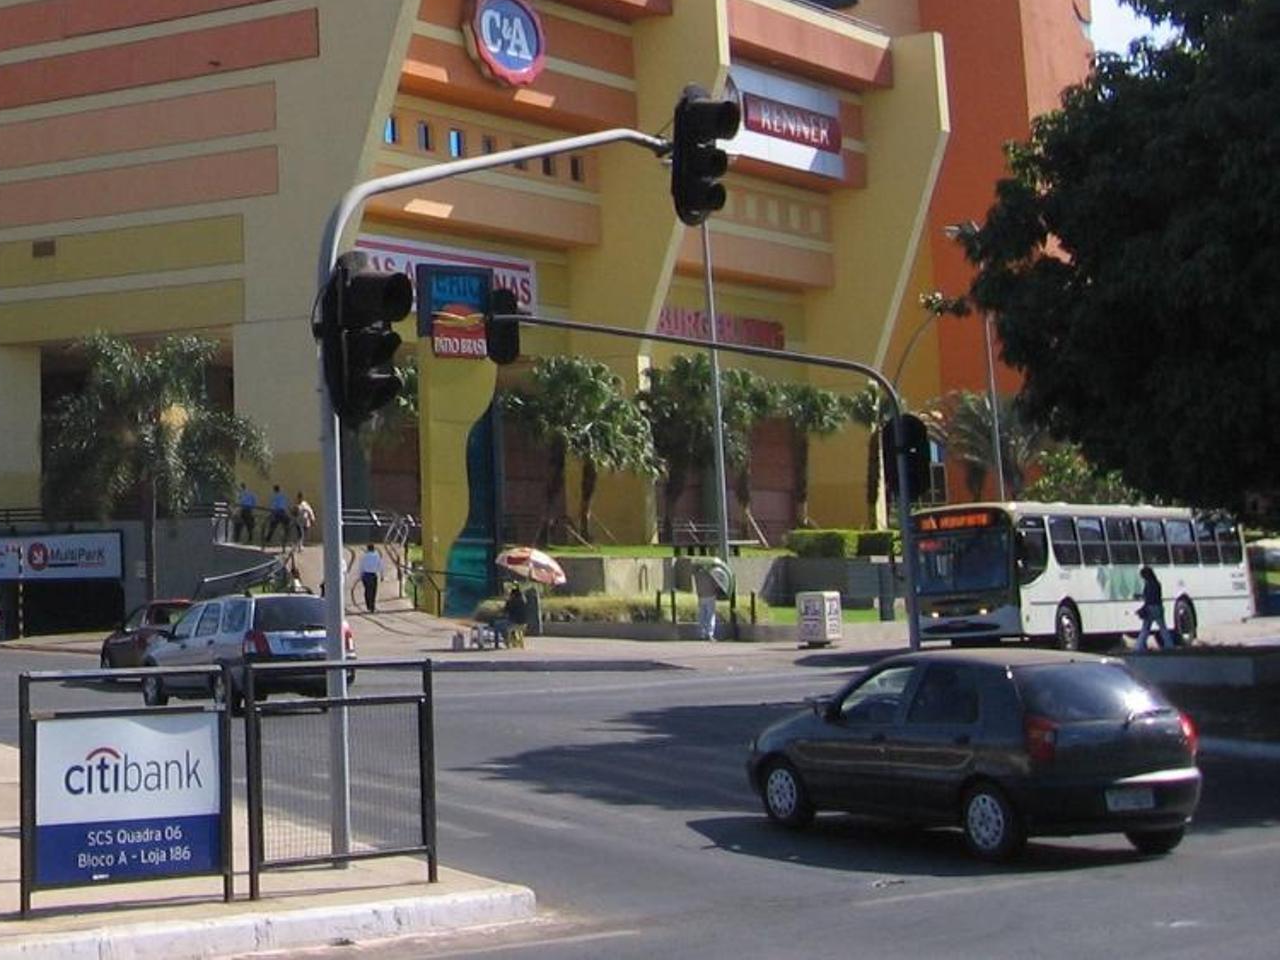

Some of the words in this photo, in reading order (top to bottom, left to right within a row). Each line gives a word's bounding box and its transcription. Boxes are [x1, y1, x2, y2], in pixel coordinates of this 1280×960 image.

[481, 8, 533, 61] C&A
[761, 102, 830, 145] RENNER
[460, 337, 488, 356] BRASI
[63, 748, 204, 796] citibank
[87, 829, 114, 847] SCS
[116, 827, 162, 844] Quadra
[164, 825, 183, 841] 06
[77, 852, 115, 869] Bloco
[117, 850, 129, 866] A
[140, 848, 167, 866] Loja
[169, 845, 192, 861] 186
